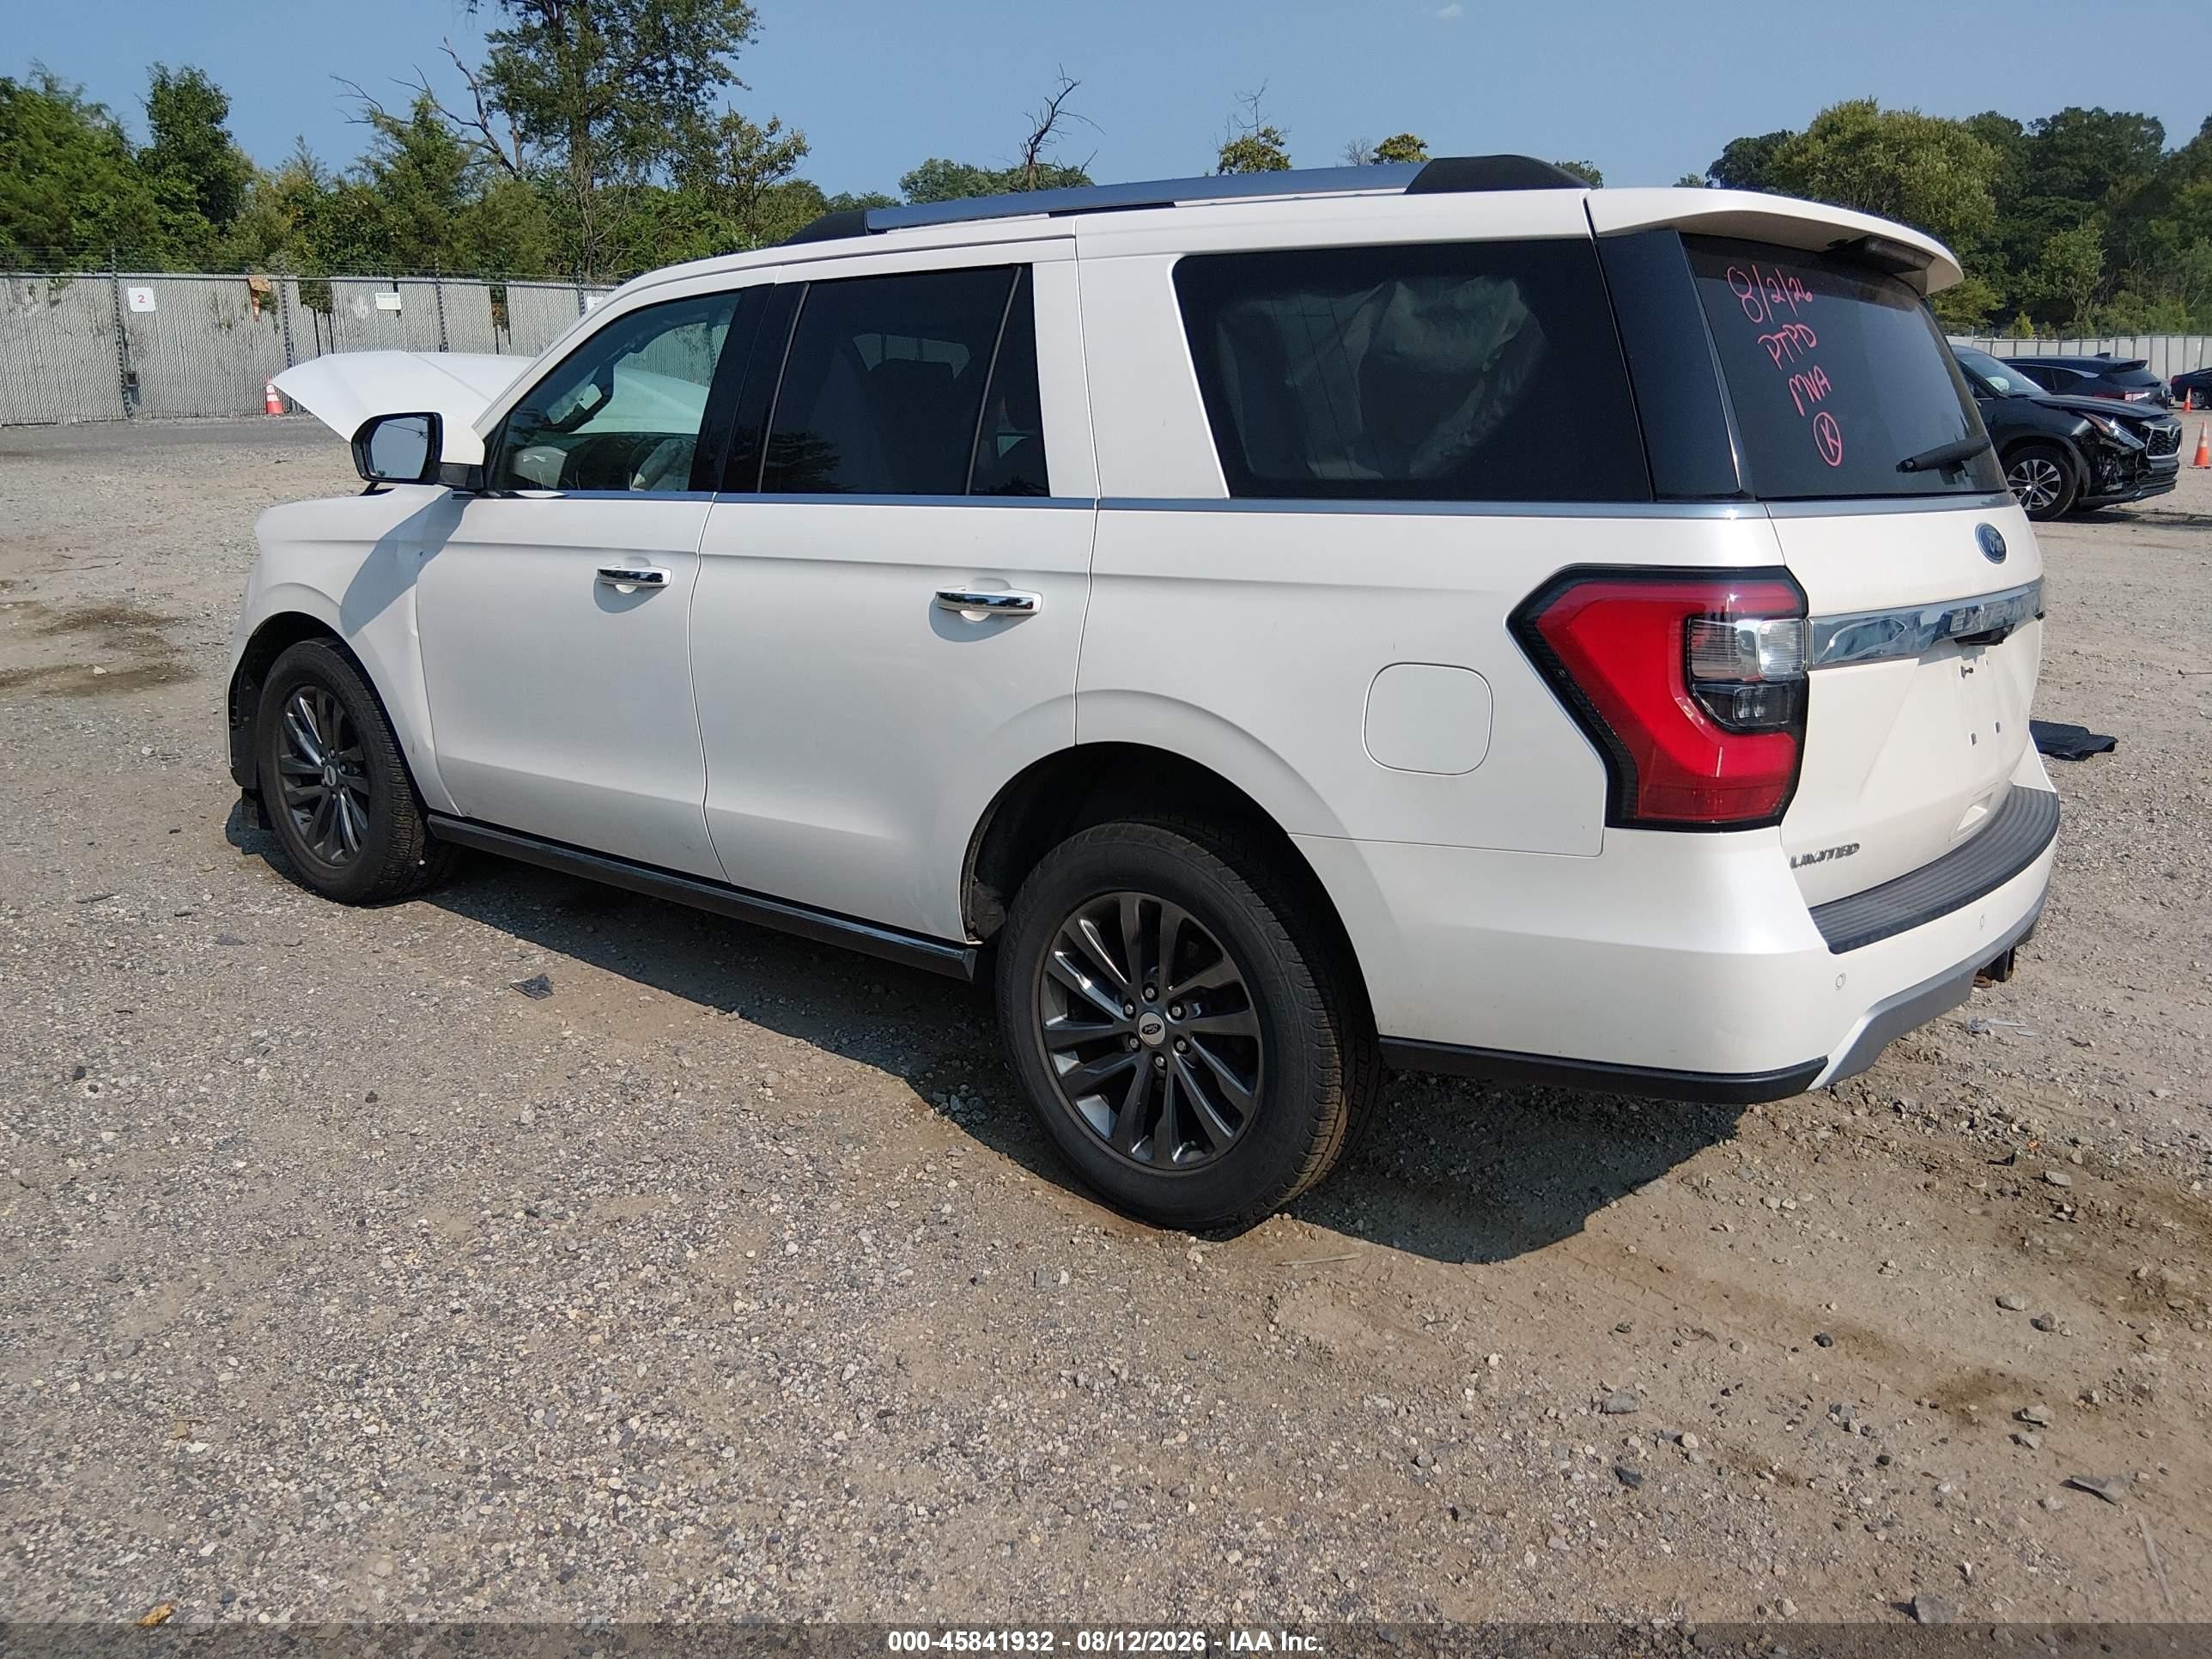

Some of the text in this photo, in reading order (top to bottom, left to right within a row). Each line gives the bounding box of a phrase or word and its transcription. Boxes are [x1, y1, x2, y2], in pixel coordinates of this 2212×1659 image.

[137, 295, 146, 303] 2
[1725, 264, 1814, 323] 8/2/26
[1758, 323, 1817, 371] PTPD
[1789, 365, 1832, 417] MVA
